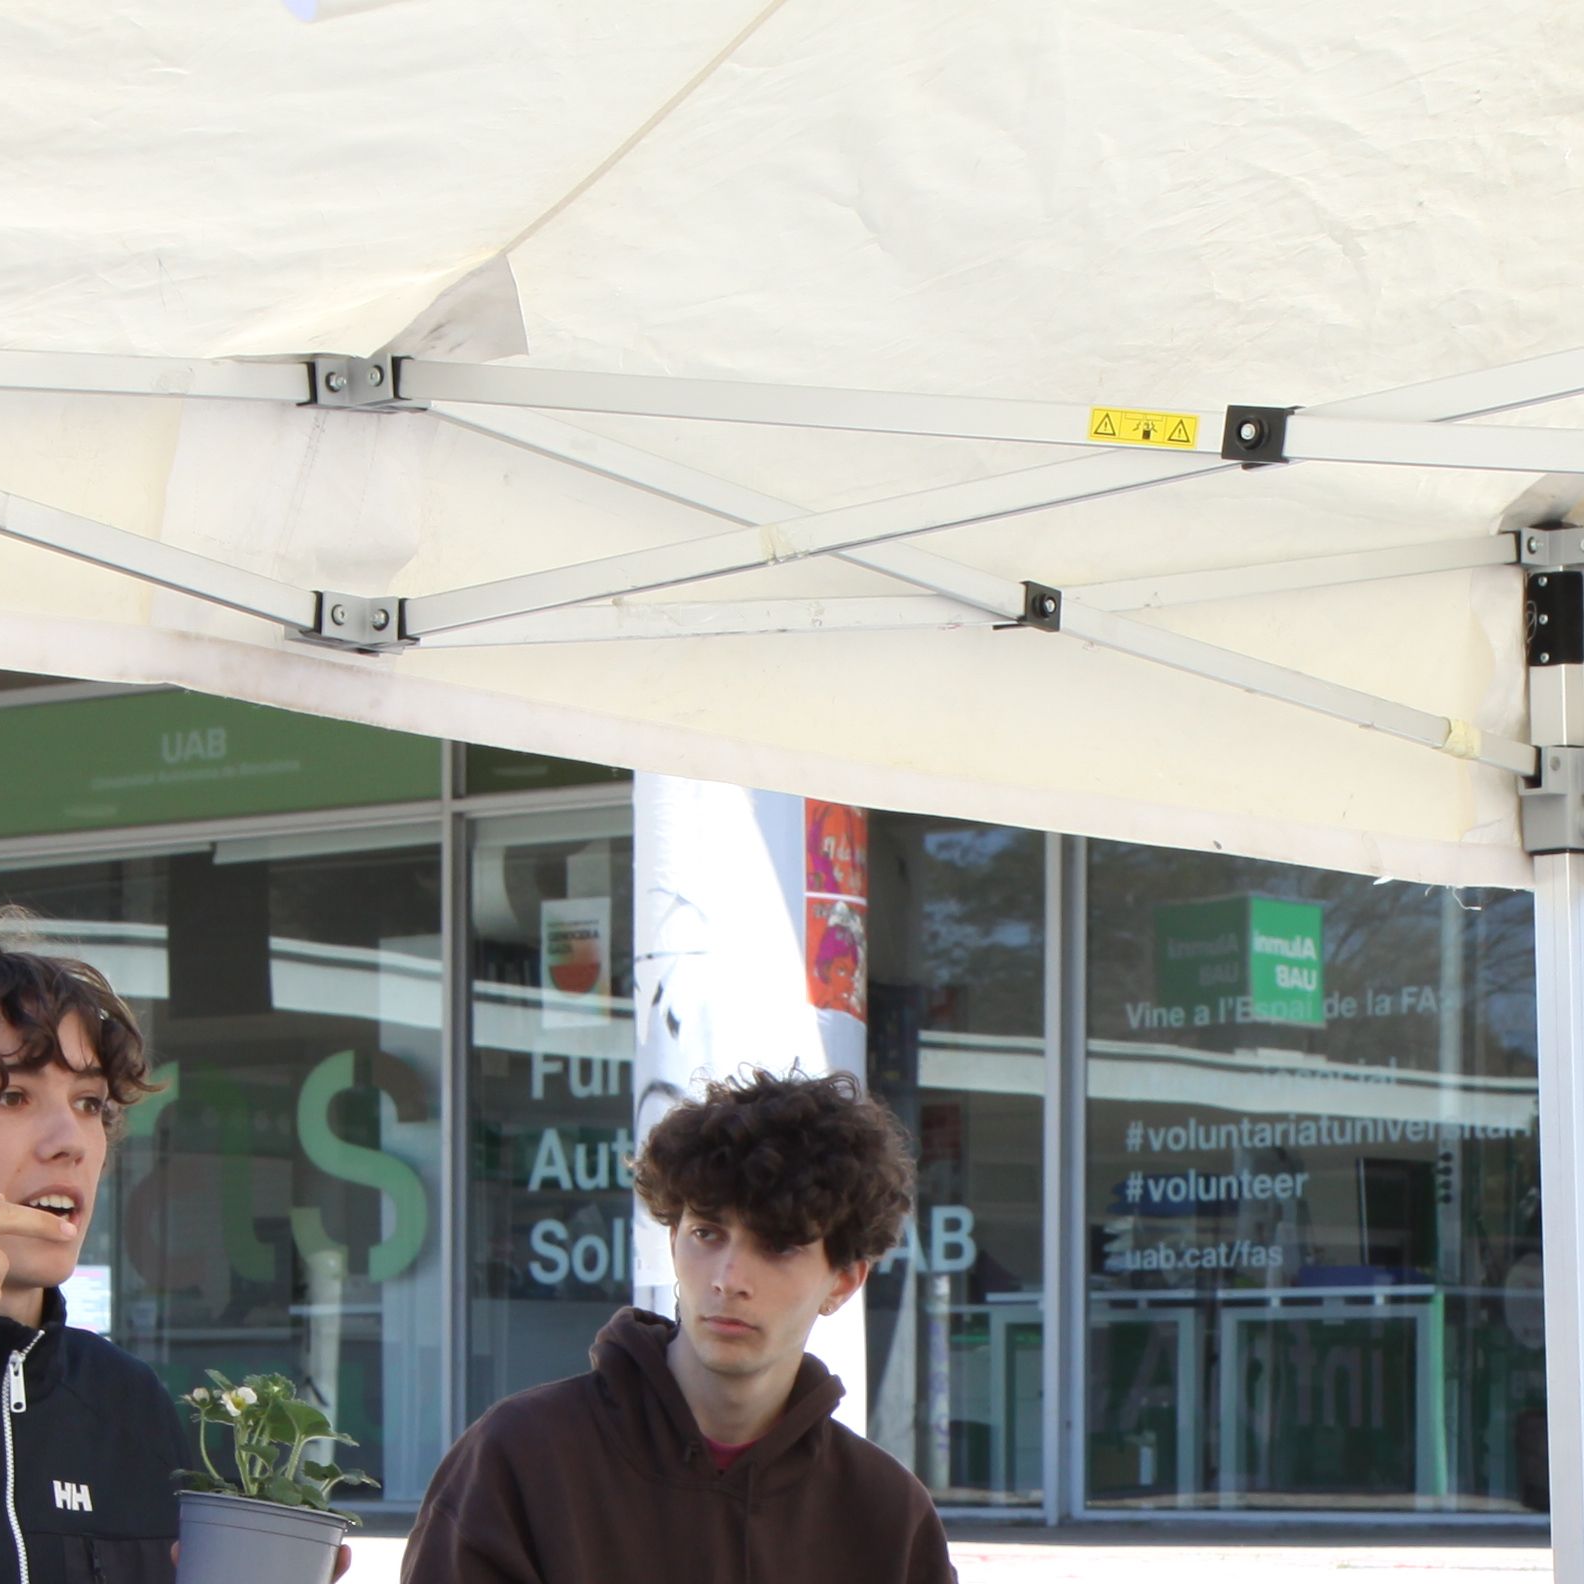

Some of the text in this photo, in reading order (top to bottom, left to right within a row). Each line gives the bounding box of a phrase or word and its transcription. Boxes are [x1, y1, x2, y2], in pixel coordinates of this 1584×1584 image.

[161, 727, 227, 764] UAB
[1125, 1002, 1185, 1030] Vine
[1193, 1004, 1210, 1026] a
[1324, 995, 1358, 1019] de
[1367, 989, 1392, 1016] la
[1125, 1168, 1309, 1203] #volunteer
[1124, 1240, 1283, 1273] uab.cat/fas
[52, 1480, 93, 1512] HH
